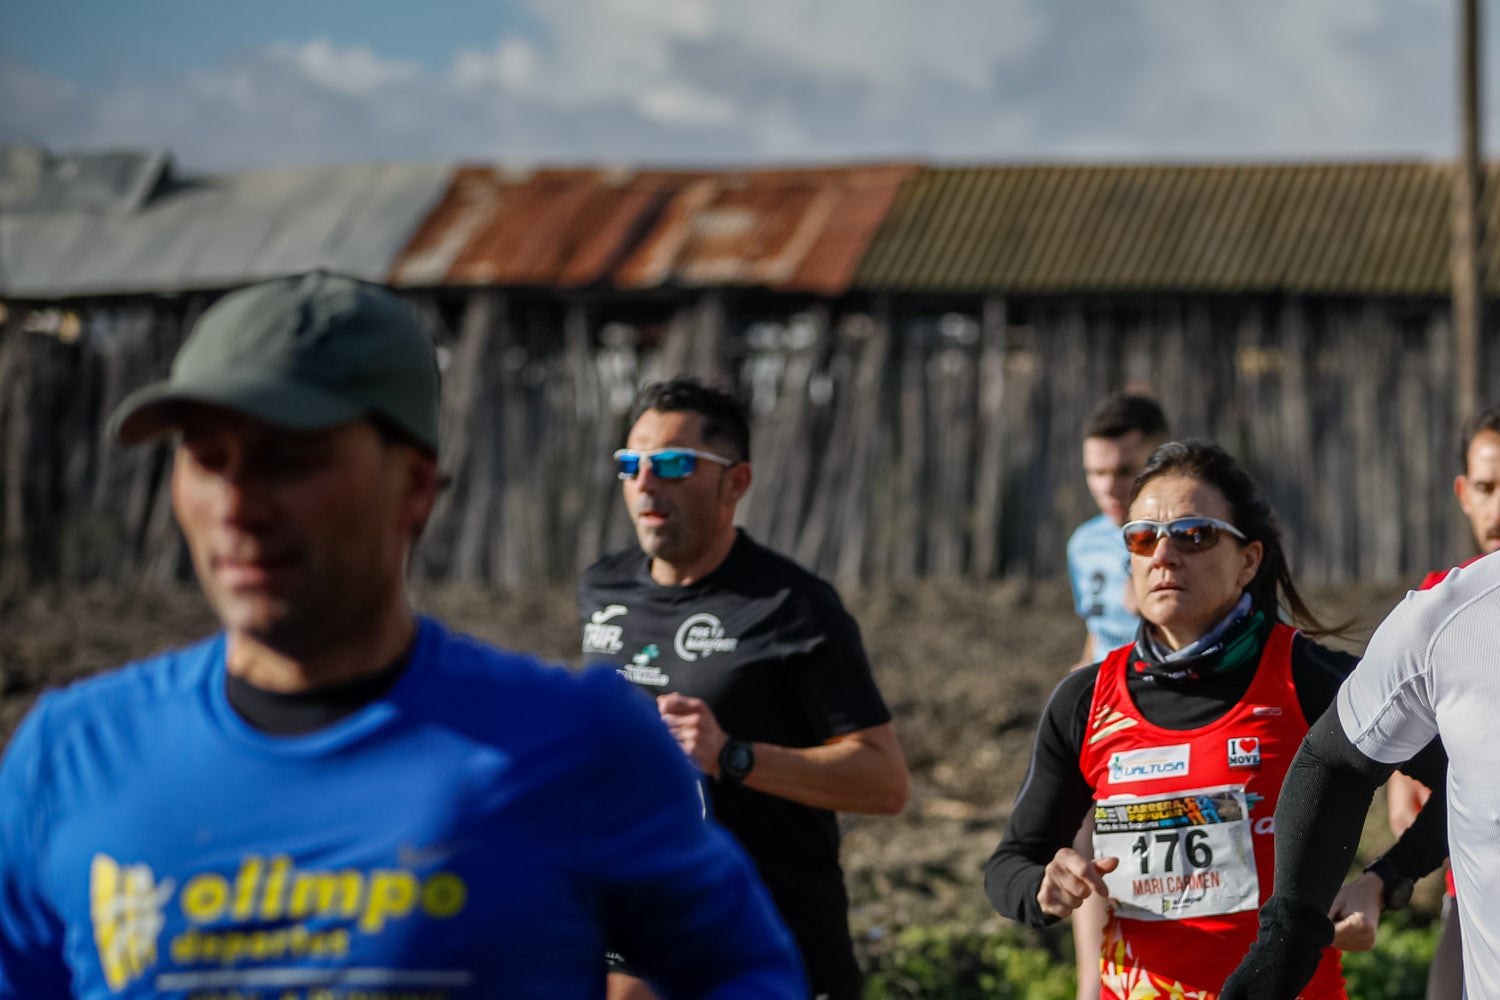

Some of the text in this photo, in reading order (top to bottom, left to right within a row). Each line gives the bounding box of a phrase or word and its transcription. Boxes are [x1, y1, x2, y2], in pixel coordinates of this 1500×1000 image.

[1229, 754, 1260, 765] MOVE
[1125, 800, 1182, 815] CARRERA
[1128, 808, 1184, 823] POPULAR
[1132, 828, 1213, 875] 176
[1132, 872, 1220, 896] MARI CARMEN
[180, 856, 468, 933] olimpo
